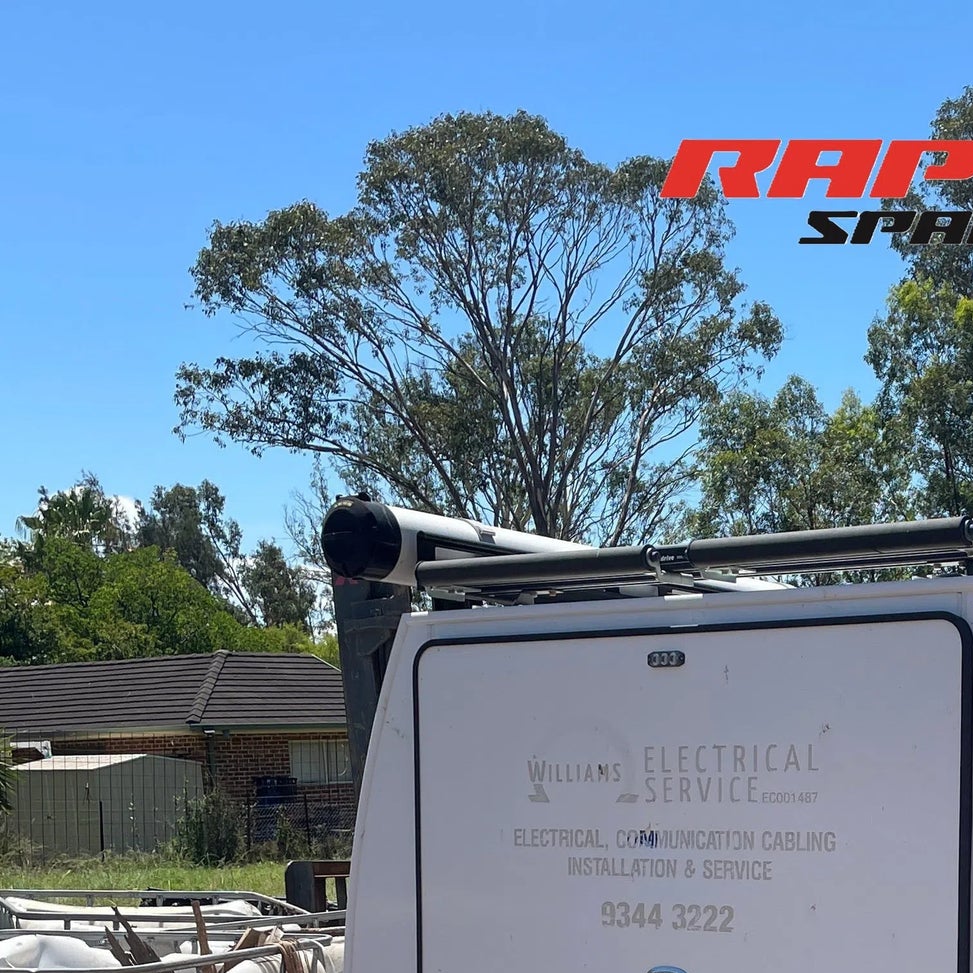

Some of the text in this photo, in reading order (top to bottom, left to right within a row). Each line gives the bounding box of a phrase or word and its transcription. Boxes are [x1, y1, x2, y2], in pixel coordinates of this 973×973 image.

[644, 744, 819, 773] ELECTRICAL
[645, 776, 758, 803] SERVICE
[513, 828, 837, 853] ELECTRICAL, COMMUNICATION CABLING
[567, 856, 773, 881] INSTALLATION & SERVICE
[600, 901, 735, 933] 9344 3222
